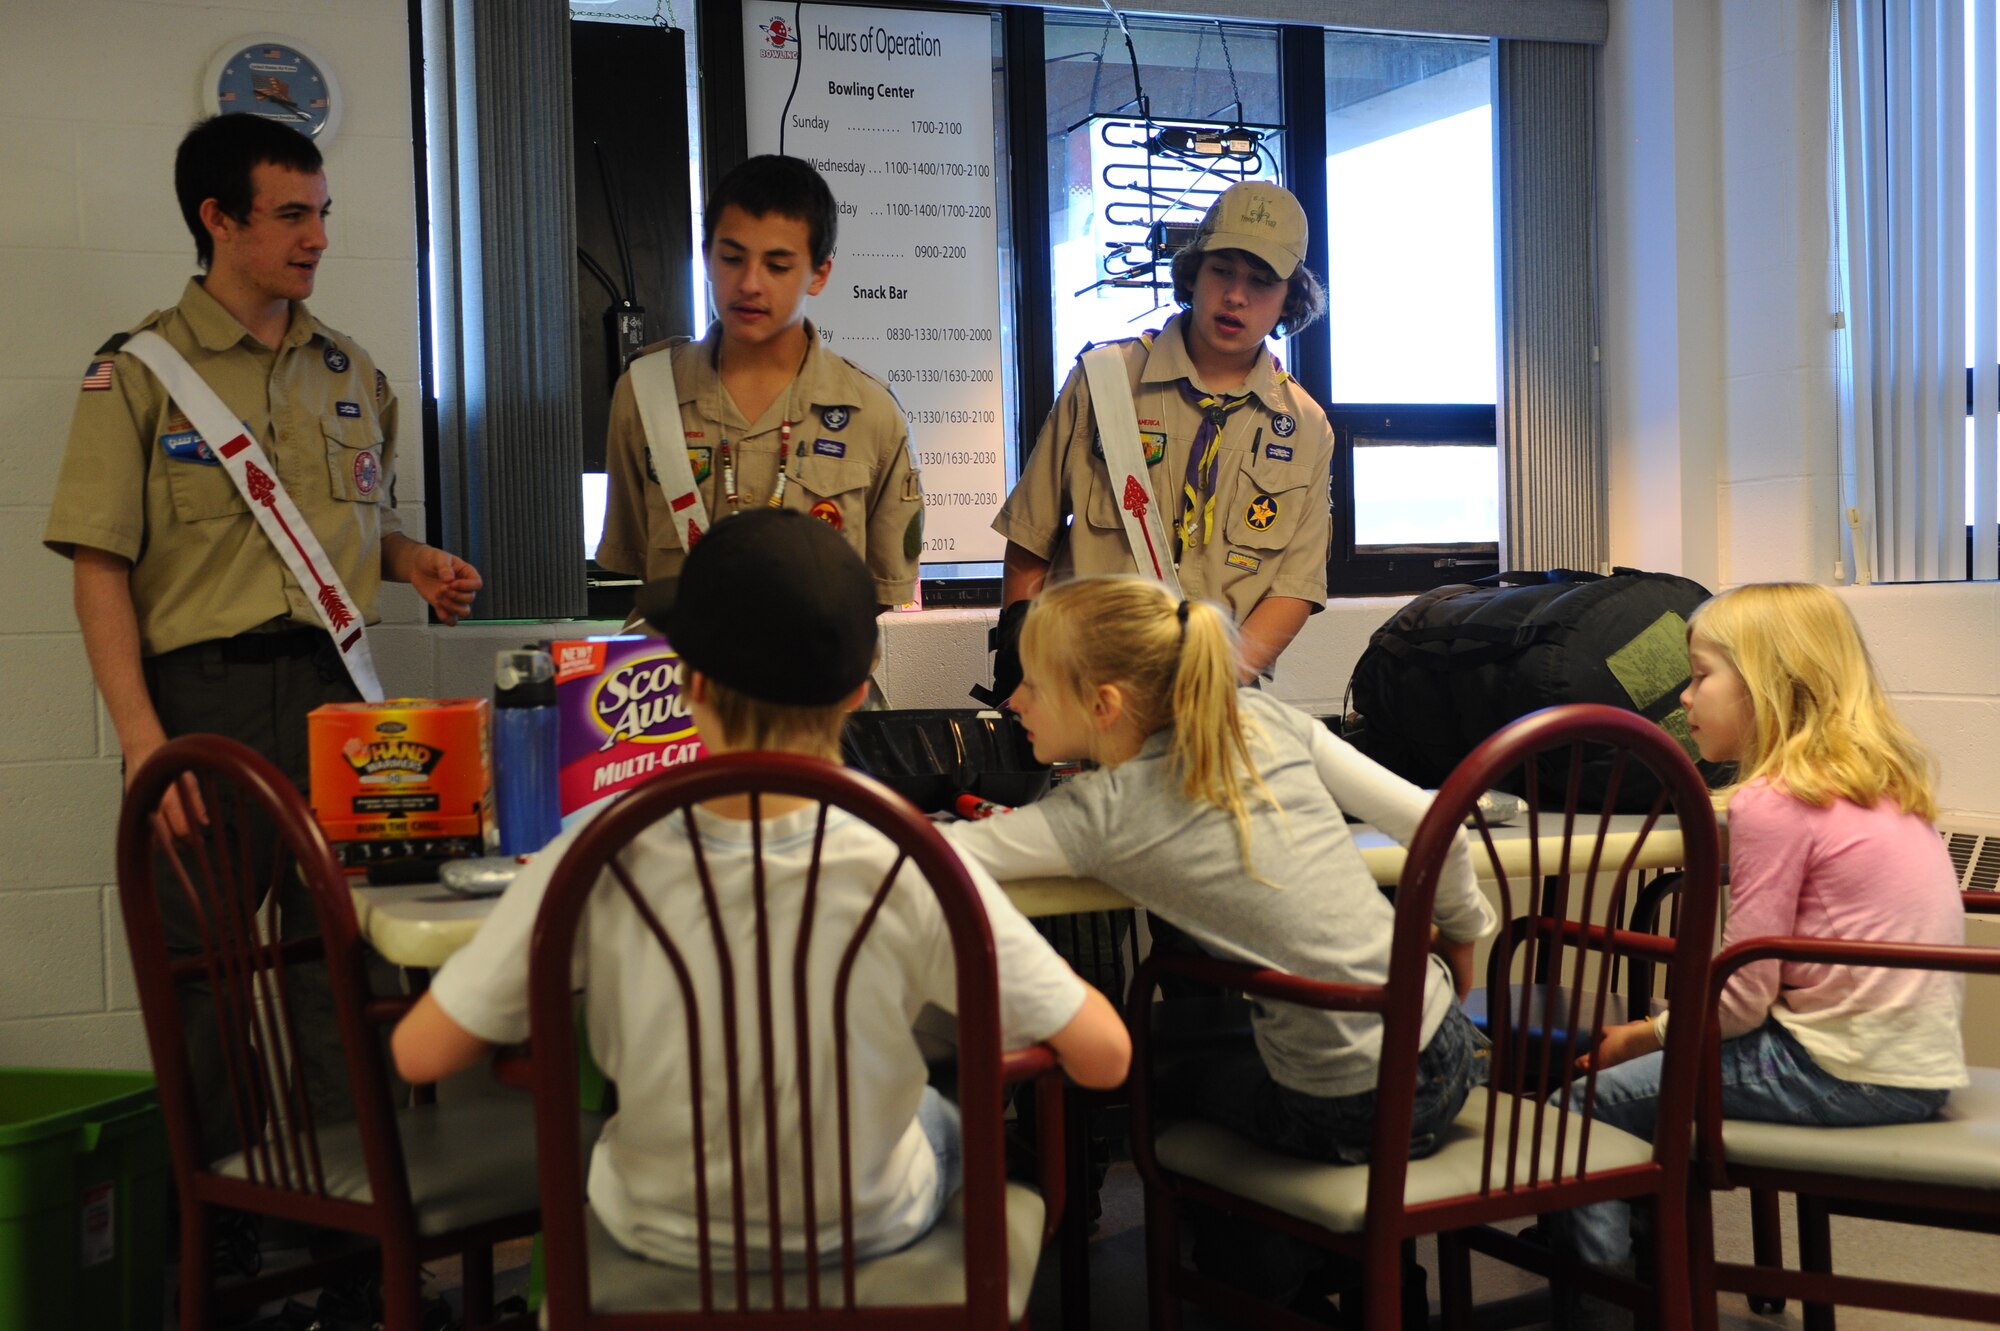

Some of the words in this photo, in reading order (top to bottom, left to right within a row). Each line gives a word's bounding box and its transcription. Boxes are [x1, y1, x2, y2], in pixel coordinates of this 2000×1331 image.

[818, 24, 857, 52] Hours
[860, 26, 874, 53] of
[876, 28, 941, 61] Operation
[760, 50, 799, 60] BOWLING
[828, 81, 874, 100] Bowling
[877, 84, 915, 98] Center
[792, 114, 829, 133] Sunday
[911, 120, 962, 135] 1700-2100
[807, 158, 866, 177] Wednesday
[885, 161, 990, 178] 1100-1400/1700-2100
[886, 203, 991, 219] 1100-1400/1700-2200
[914, 245, 967, 259] 0900-2200
[853, 285, 886, 300] Snack
[889, 285, 908, 300] Bar
[886, 328, 992, 341] 0830-1330/1700-2000
[888, 369, 993, 382] 0630-1330/1630-2000
[907, 411, 995, 424] 0-1330/1630-2100
[919, 452, 996, 465] 1330/1630-2030
[925, 493, 998, 506] 330/1700-2030
[931, 538, 955, 551] 2012
[599, 662, 685, 715] Scoo
[599, 693, 694, 752] Awa
[371, 740, 431, 764] HAND
[593, 742, 701, 791] MULTI-CAT
